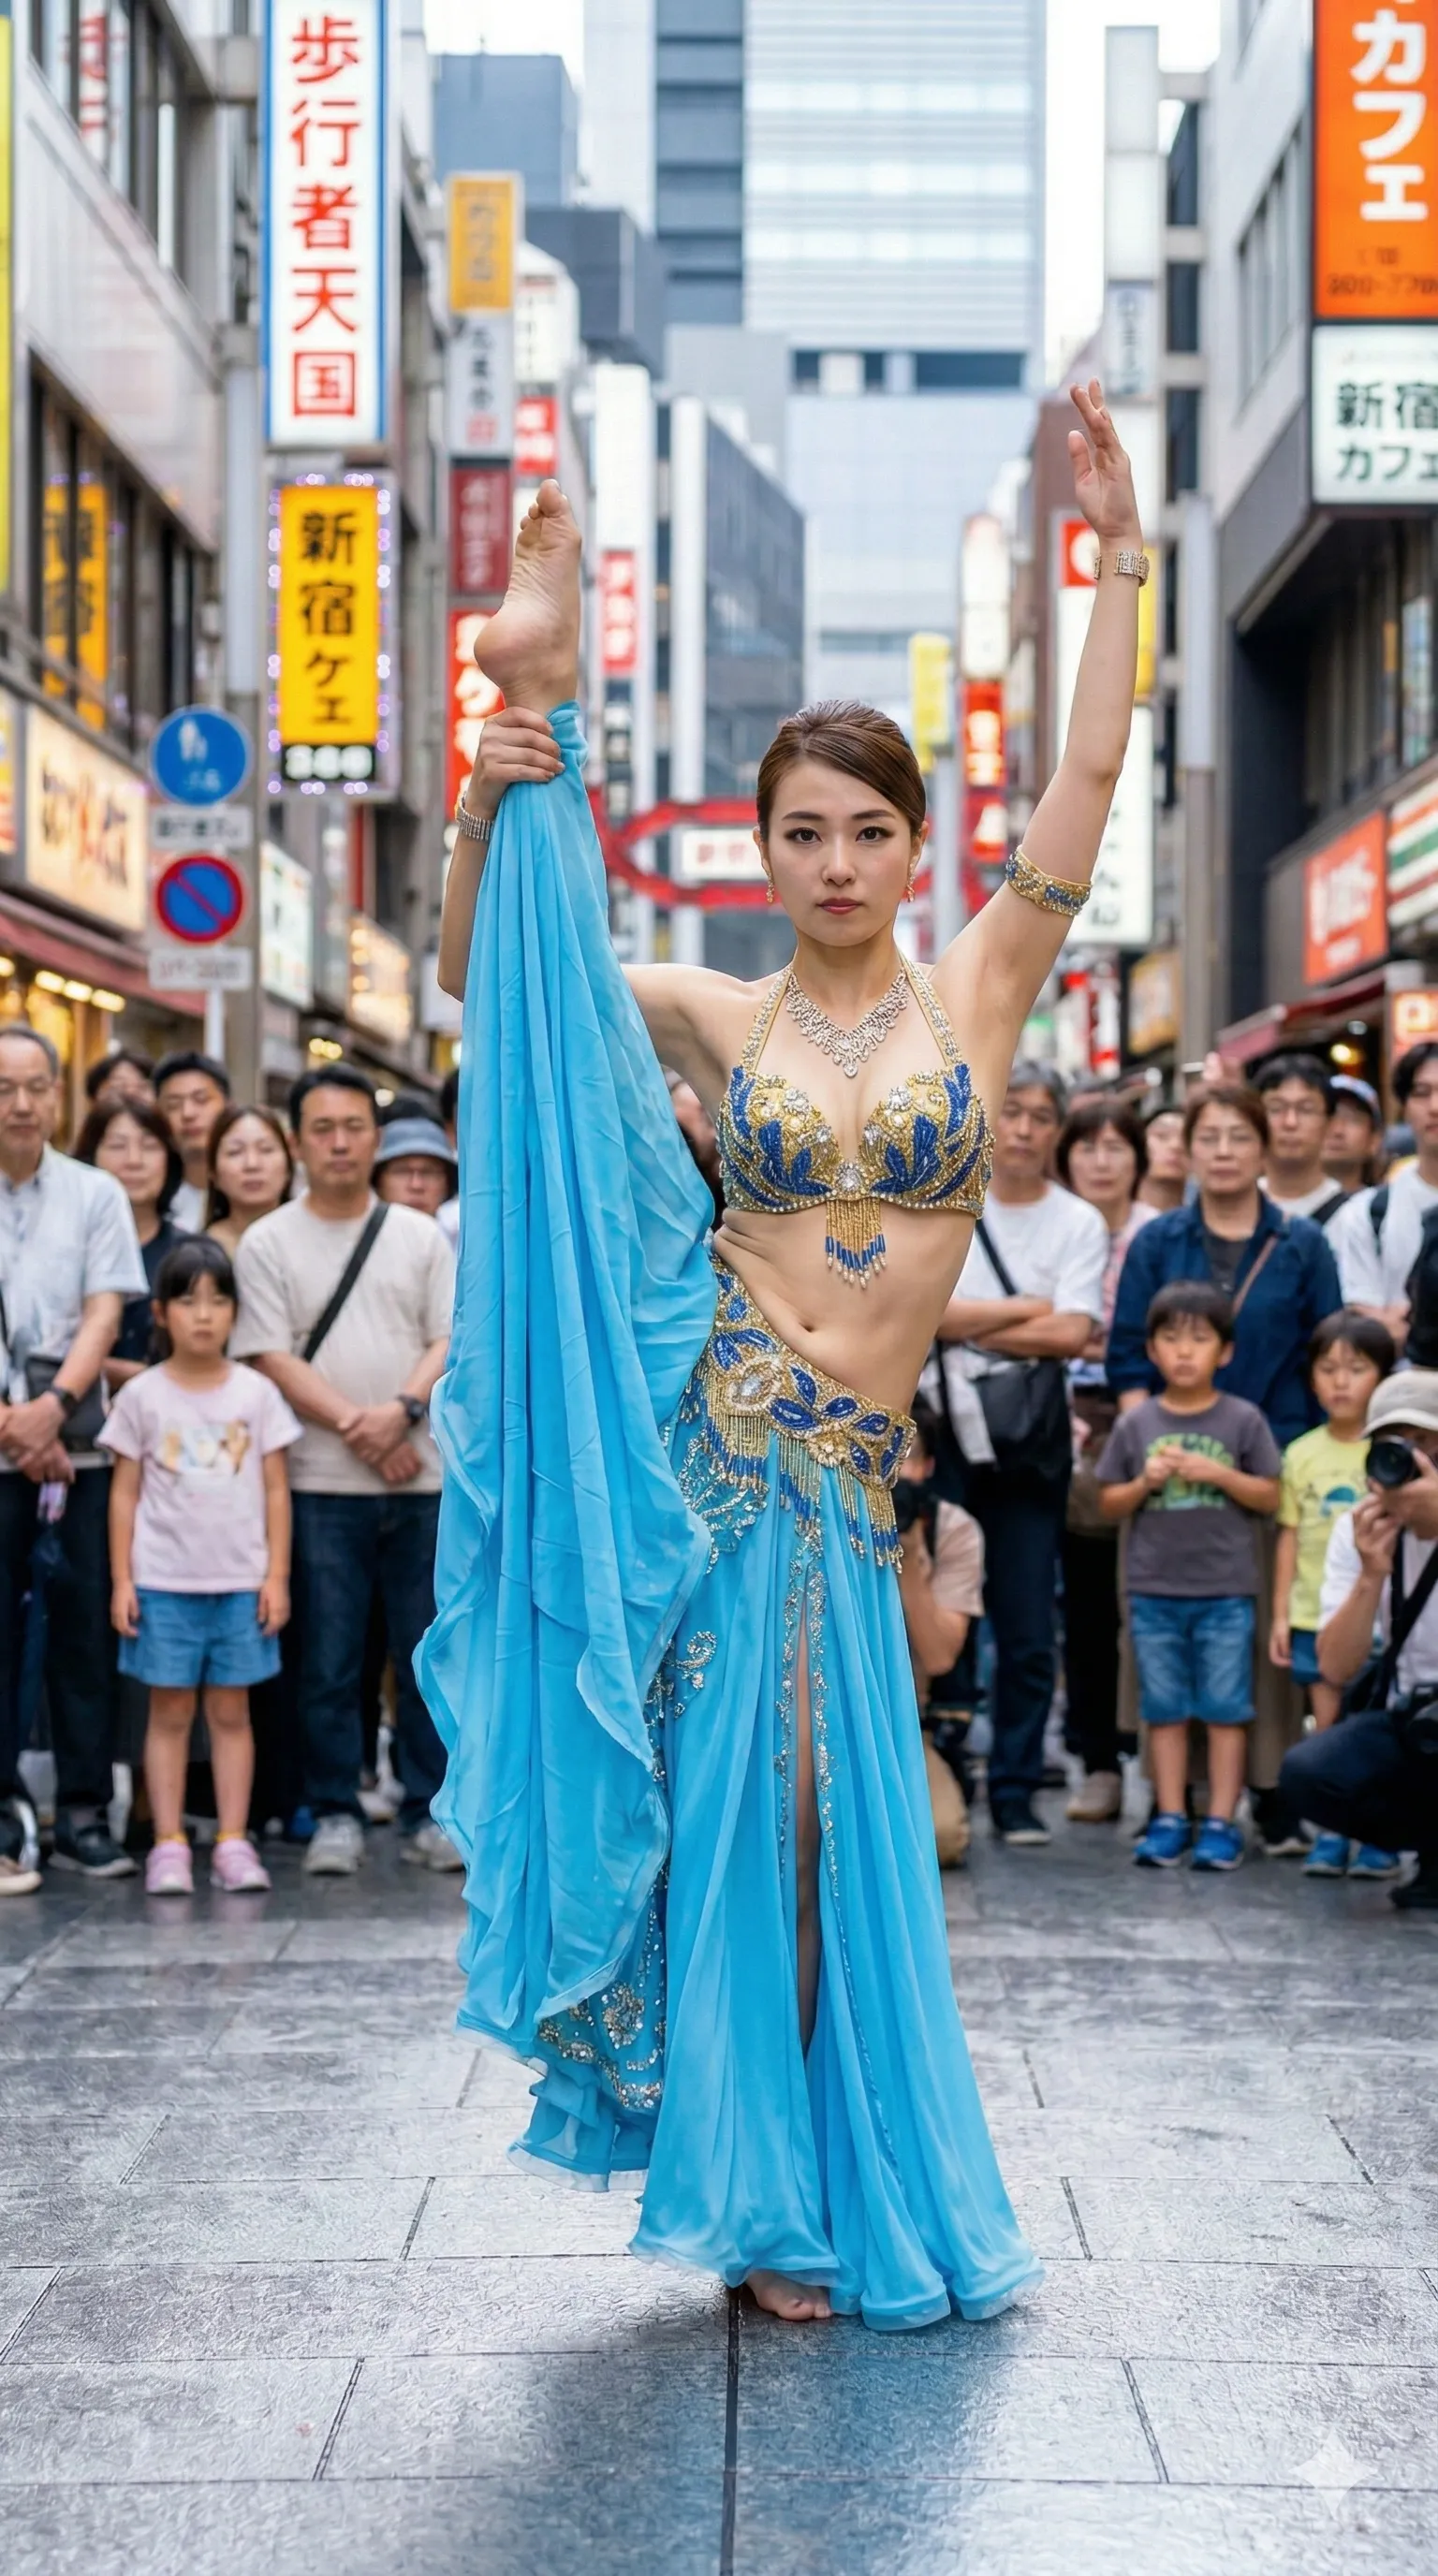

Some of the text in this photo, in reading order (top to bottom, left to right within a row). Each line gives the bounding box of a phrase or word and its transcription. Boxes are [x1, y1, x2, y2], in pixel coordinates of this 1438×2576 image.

[291, 16, 360, 417] 歩行者天国
[1350, 0, 1429, 222] カフェ
[1336, 380, 1438, 431] 新宿
